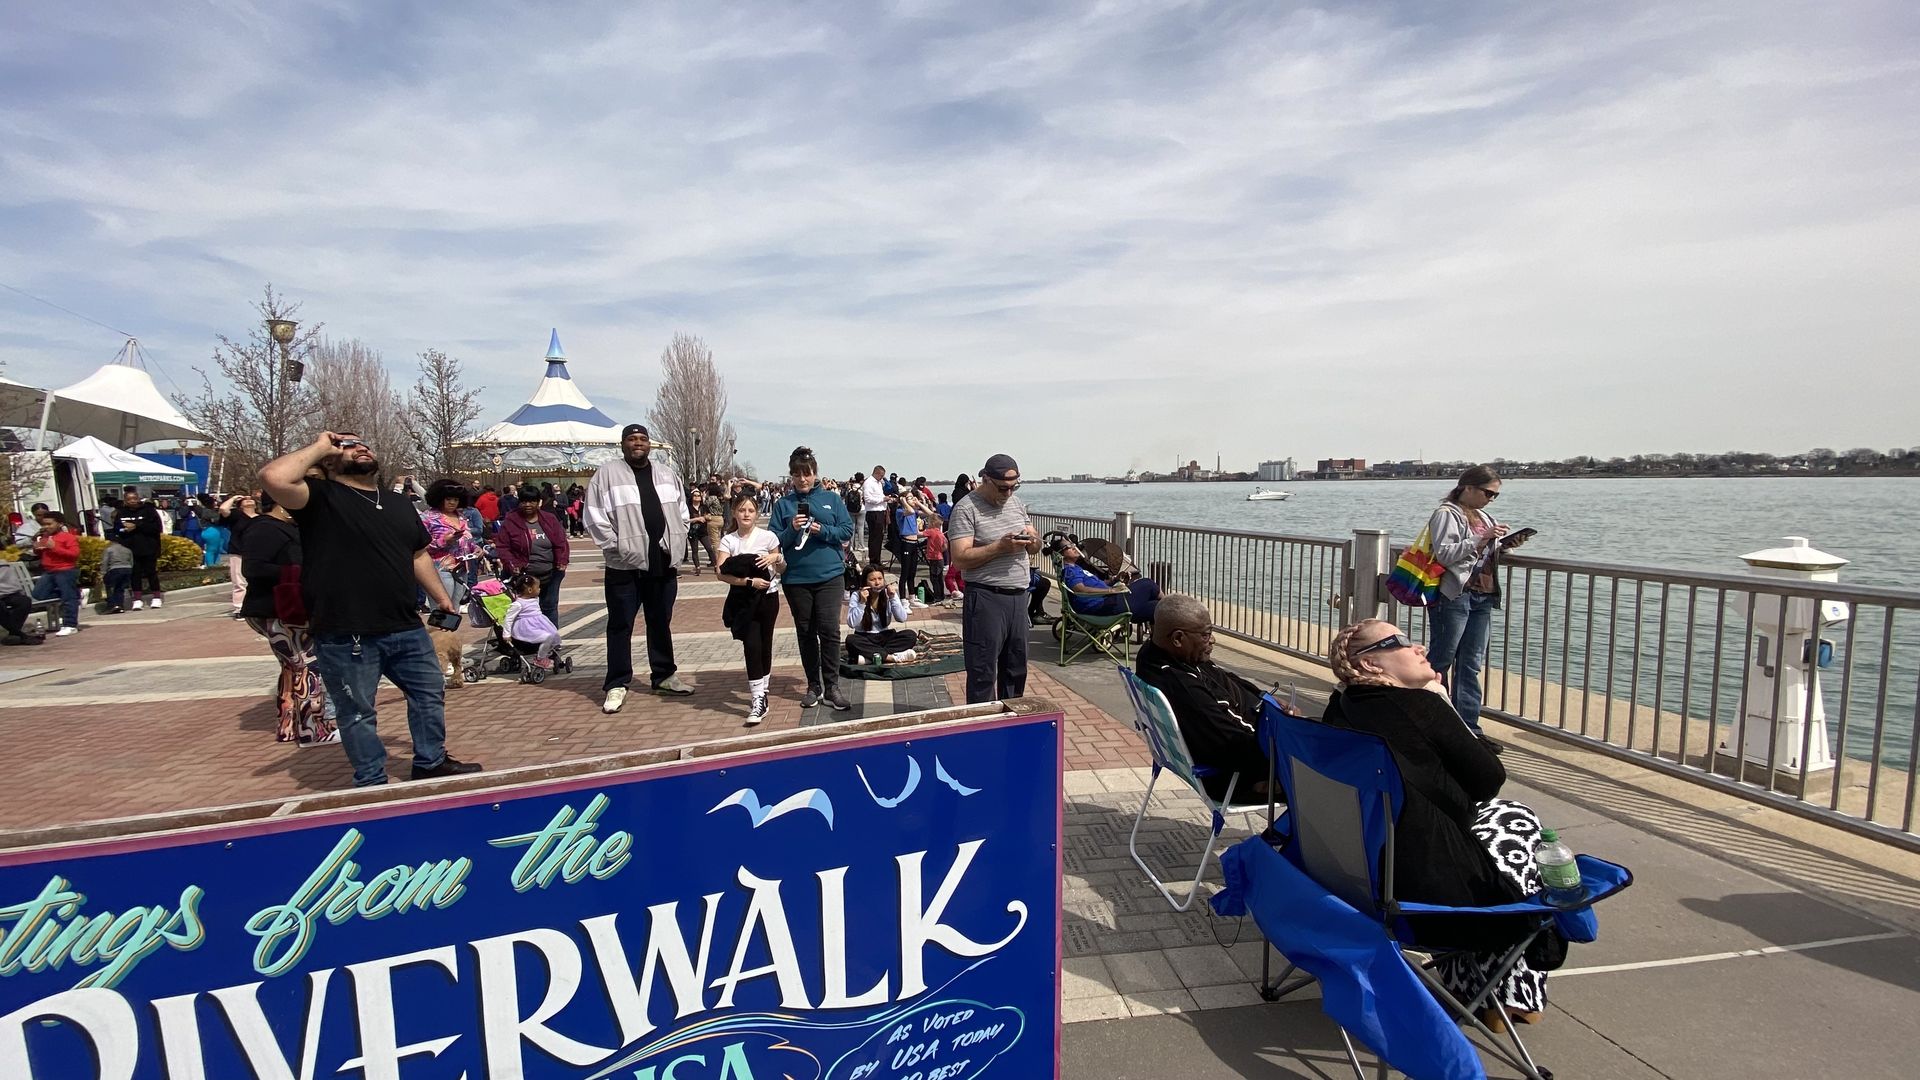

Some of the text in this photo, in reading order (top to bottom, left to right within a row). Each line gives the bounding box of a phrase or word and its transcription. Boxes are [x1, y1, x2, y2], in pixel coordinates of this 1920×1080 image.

[0, 792, 634, 989] tings from the
[886, 1009, 974, 1045] AS VOTED
[891, 1038, 940, 1070] USA
[952, 1023, 1005, 1051] TODAY
[927, 1059, 971, 1080] BEST
